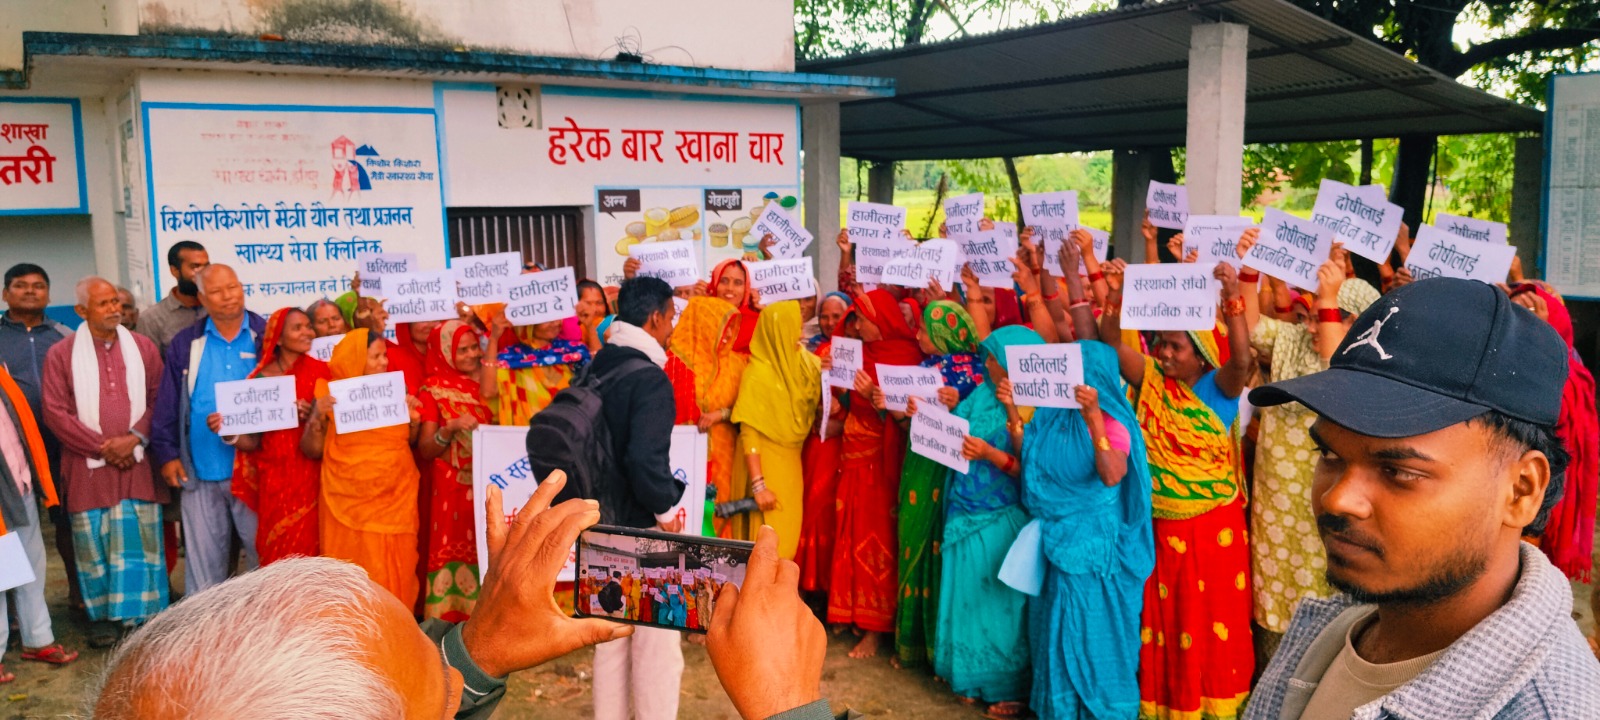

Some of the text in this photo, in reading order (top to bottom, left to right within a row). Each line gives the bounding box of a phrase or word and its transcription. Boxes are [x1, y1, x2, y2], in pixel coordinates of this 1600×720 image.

[548, 117, 784, 165] हरेक बार खाना चार
[275, 201, 307, 228] मैत्री
[311, 201, 340, 227] यौन
[343, 206, 370, 226] तथा
[852, 209, 901, 227] हामीलाई
[1335, 193, 1385, 227] दोषीलाई
[766, 210, 807, 248] हामीलाई
[1275, 220, 1318, 254] दोषीलाई
[235, 243, 284, 263] स्वास्थ्य
[288, 235, 318, 262] सेवा
[1361, 230, 1383, 251] गर
[1251, 243, 1316, 279] छानविन गर
[1428, 240, 1480, 276] दोषीलाई
[464, 261, 509, 279] छलिलाई
[754, 262, 807, 281] हामीलाई
[886, 263, 922, 280] कार्वाही
[397, 277, 442, 295] ठगीलाई
[509, 275, 569, 300] हामीलाई
[791, 276, 800, 291] दे
[1134, 274, 1207, 291] संस्थाको सांचो
[388, 298, 426, 315] कार्वाही
[430, 300, 446, 312] गर
[510, 301, 548, 318] न्याय
[553, 296, 563, 311] दे
[1126, 302, 1181, 318] सार्वजनिक
[1185, 306, 1203, 318] गर
[1019, 352, 1068, 375] छलिलाई
[234, 385, 280, 406] ठगीलाई
[349, 381, 393, 403] ठगीलाई
[1013, 378, 1070, 399] कार्वाही गर
[223, 408, 263, 427] कार्वाही
[267, 408, 284, 421] गर
[340, 403, 378, 424] कार्वाही
[382, 404, 401, 418] गर
